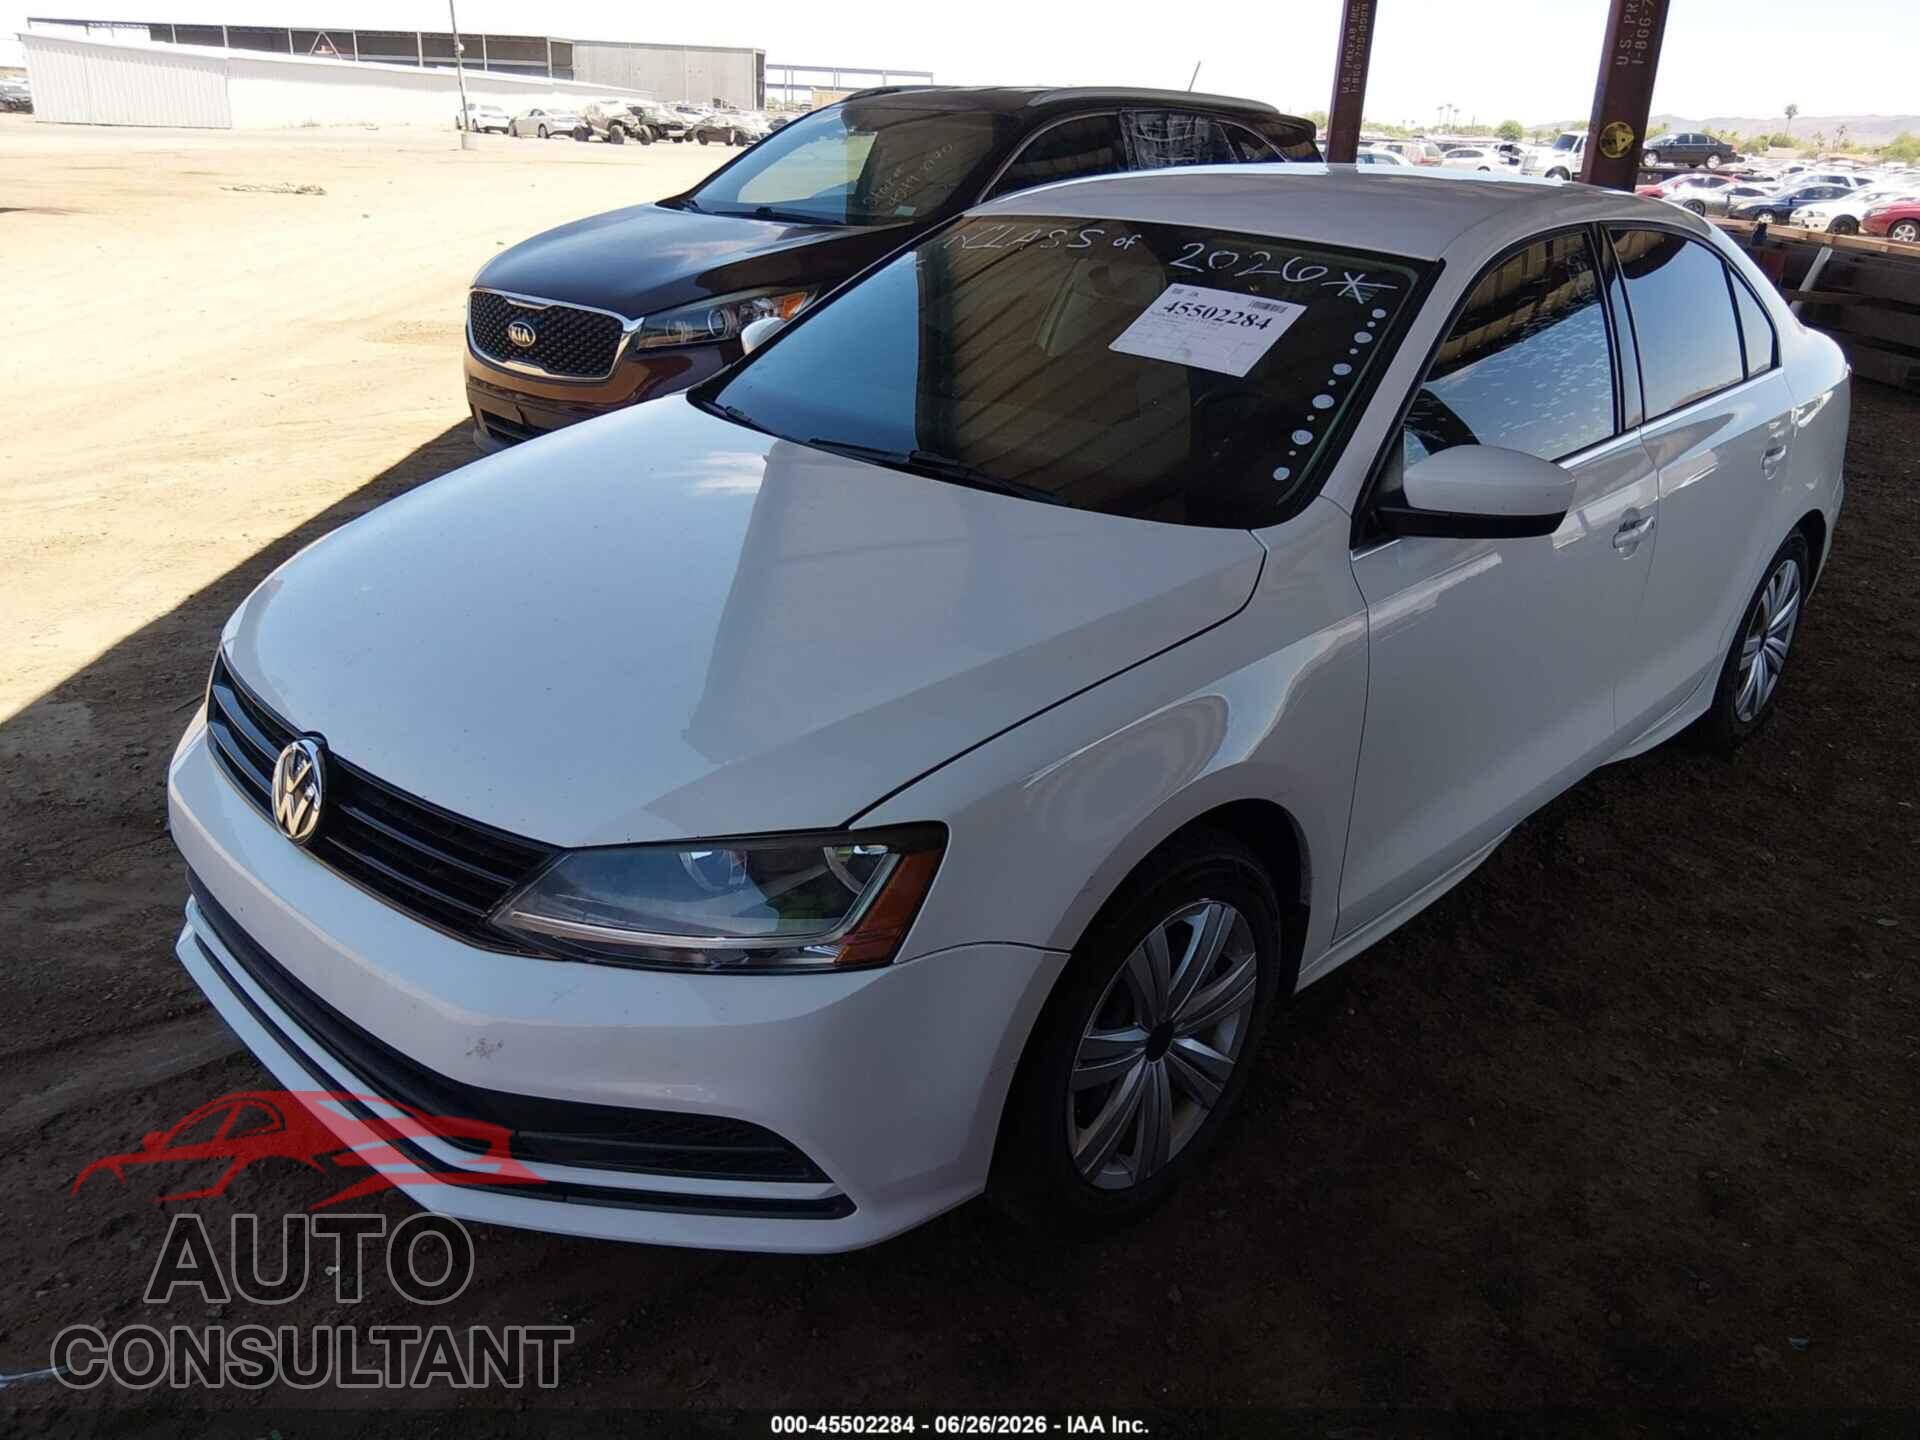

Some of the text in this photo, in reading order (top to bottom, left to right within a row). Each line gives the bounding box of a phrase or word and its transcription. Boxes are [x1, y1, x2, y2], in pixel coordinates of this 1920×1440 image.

[1616, 0, 1640, 65] U.S. PR
[1112, 234, 1142, 250] of
[1163, 300, 1273, 331] 45502284
[509, 324, 531, 343] KIA
[274, 741, 320, 838] VW
